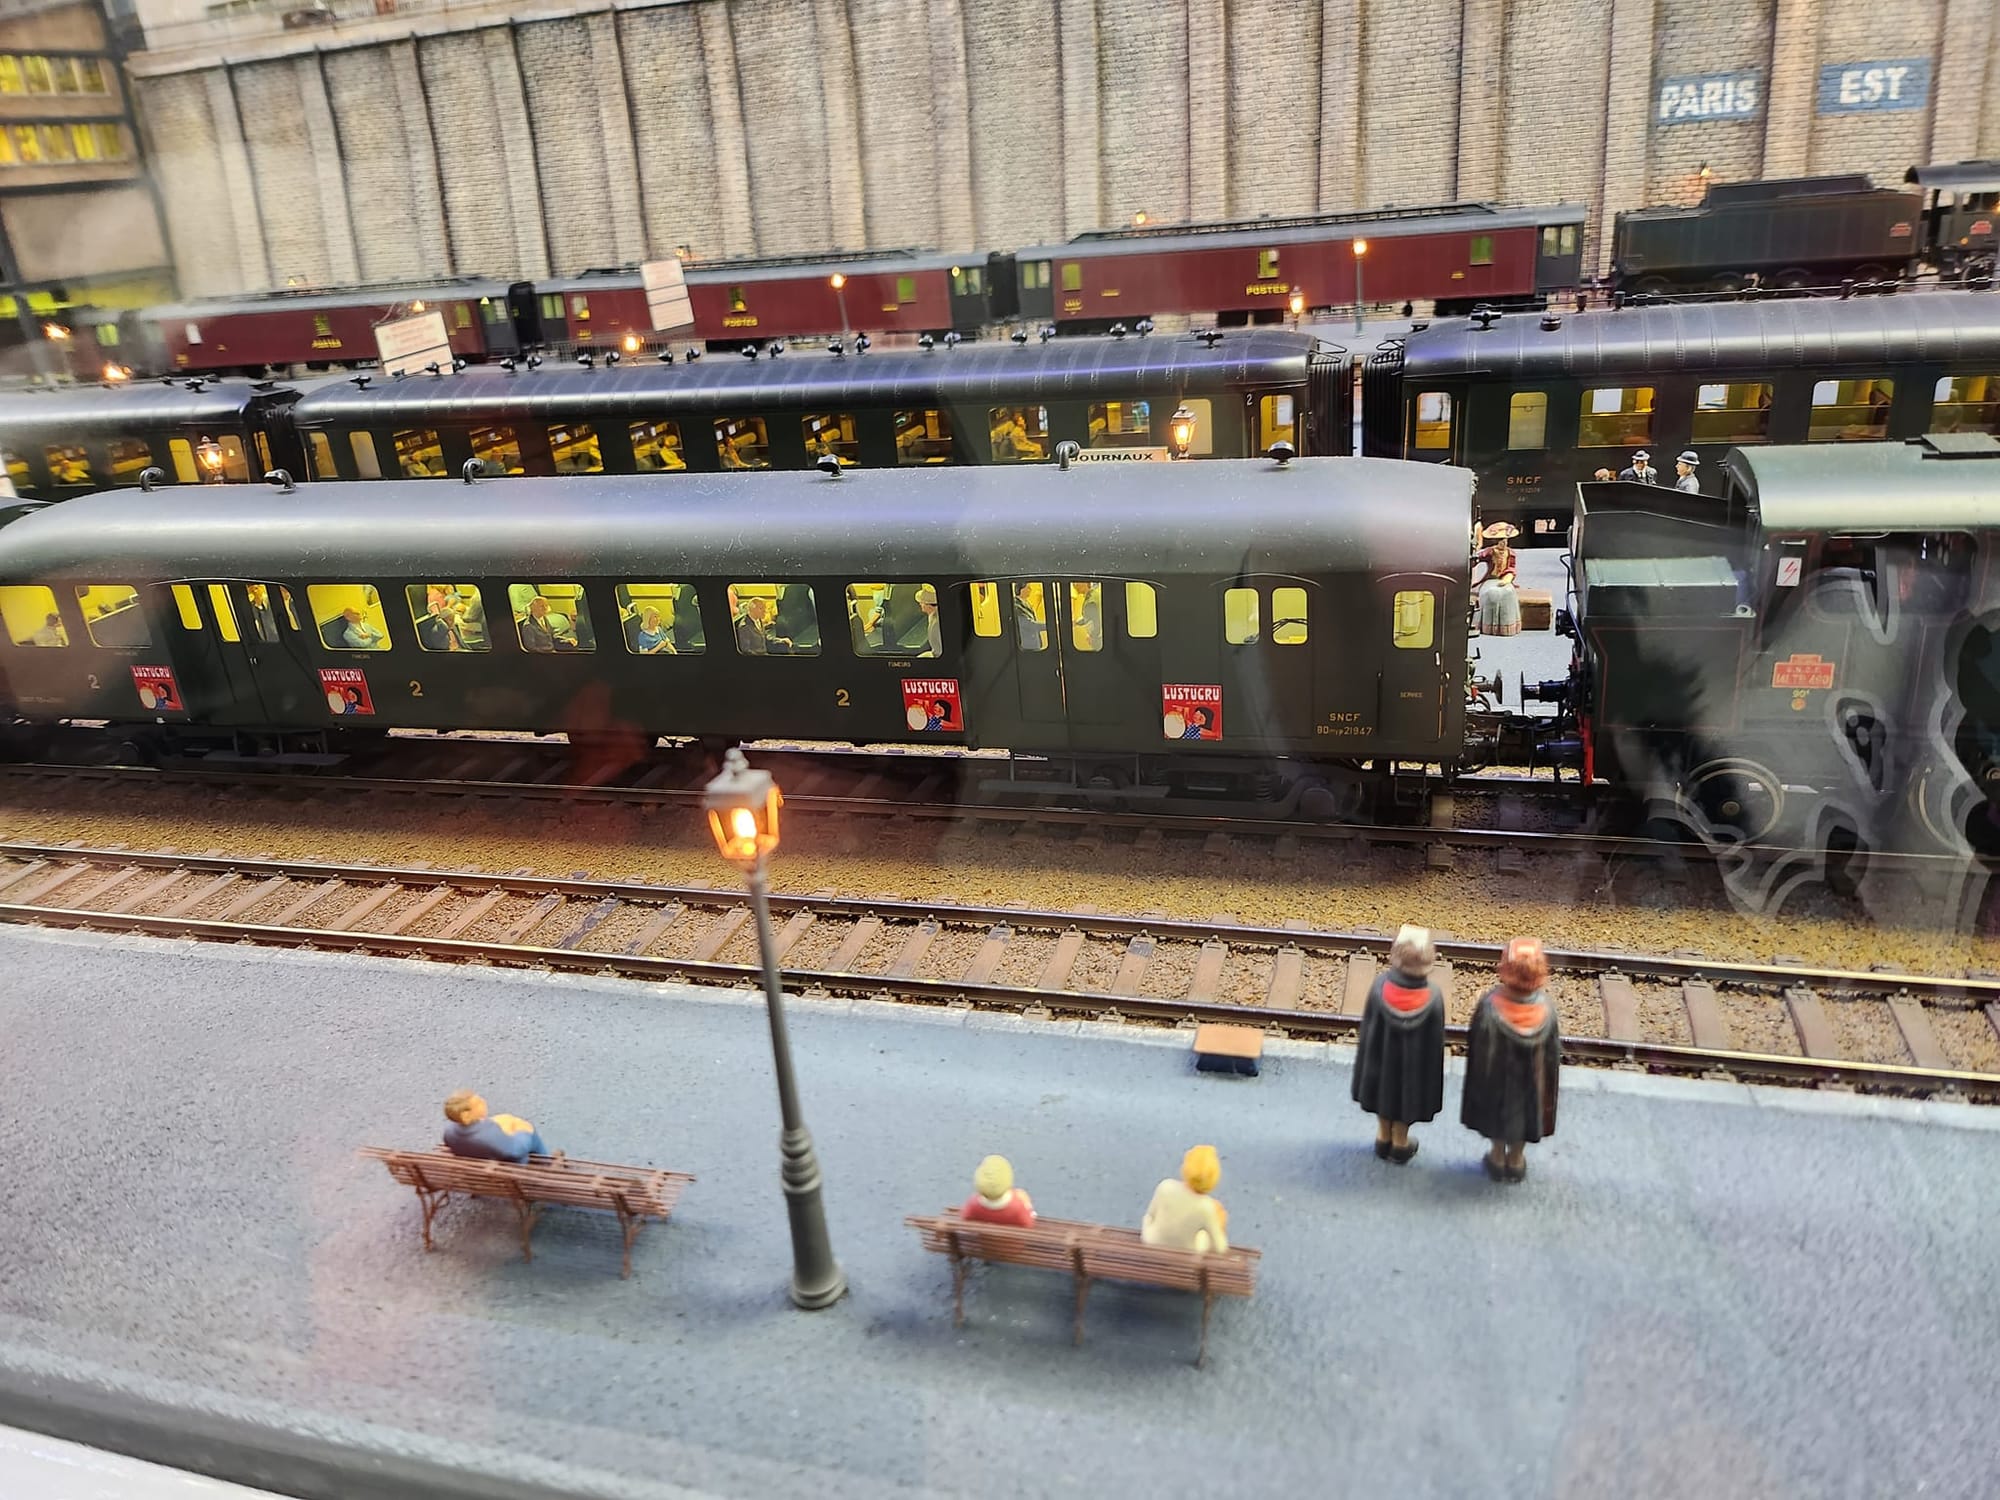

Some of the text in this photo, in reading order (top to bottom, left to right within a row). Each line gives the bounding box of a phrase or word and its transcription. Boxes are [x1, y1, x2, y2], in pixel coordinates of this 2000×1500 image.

[1839, 67, 1908, 104] EST
[1659, 80, 1757, 118] PARIS
[1246, 283, 1289, 296] POSTES
[1246, 393, 1253, 406] 2
[1507, 476, 1542, 485] SNCF
[87, 674, 100, 689] 2
[320, 670, 362, 682] LUSTUCRU
[408, 680, 424, 697] 2
[904, 681, 956, 694] LUSTUCRU
[1163, 687, 1220, 701] LUSTUCRU
[835, 688, 851, 707] 2
[1329, 713, 1361, 721] SNCF
